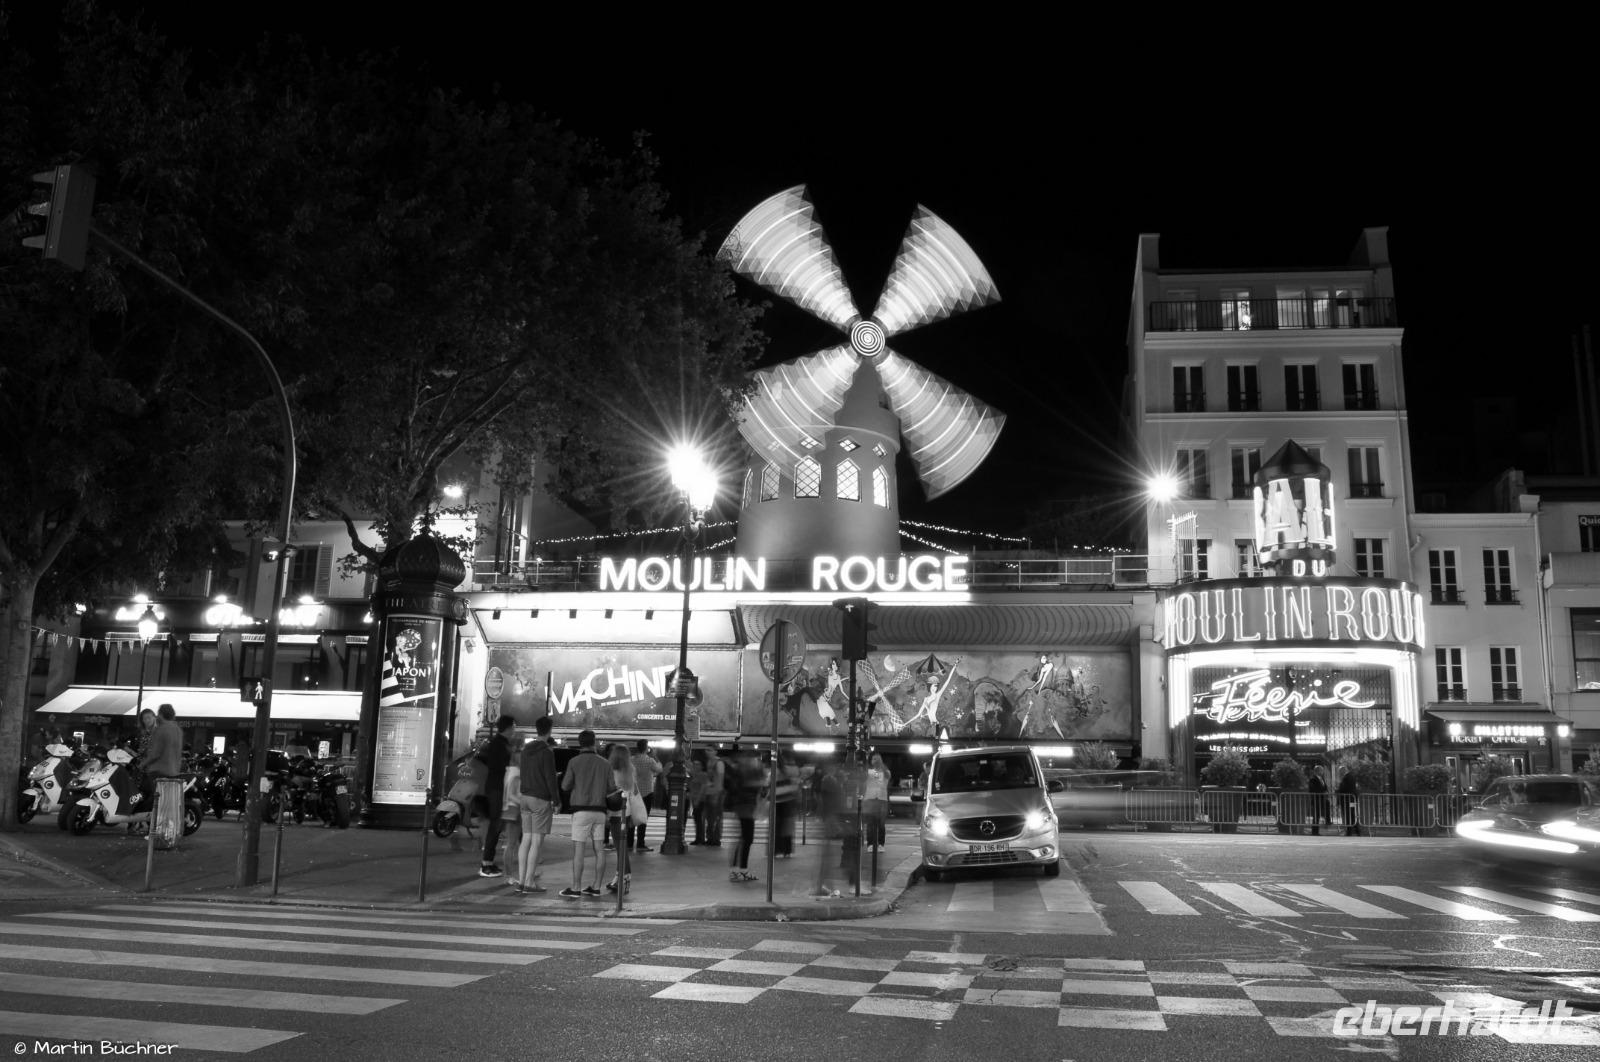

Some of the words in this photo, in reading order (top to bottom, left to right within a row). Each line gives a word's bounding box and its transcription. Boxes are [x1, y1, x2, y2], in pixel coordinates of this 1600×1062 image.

[599, 556, 767, 592] MOULIN
[811, 556, 969, 592] ROUGE
[1292, 559, 1326, 577] DU
[391, 667, 427, 678] JAPON
[1450, 735, 1482, 743] TICKET
[1491, 736, 1527, 744] OFFICE
